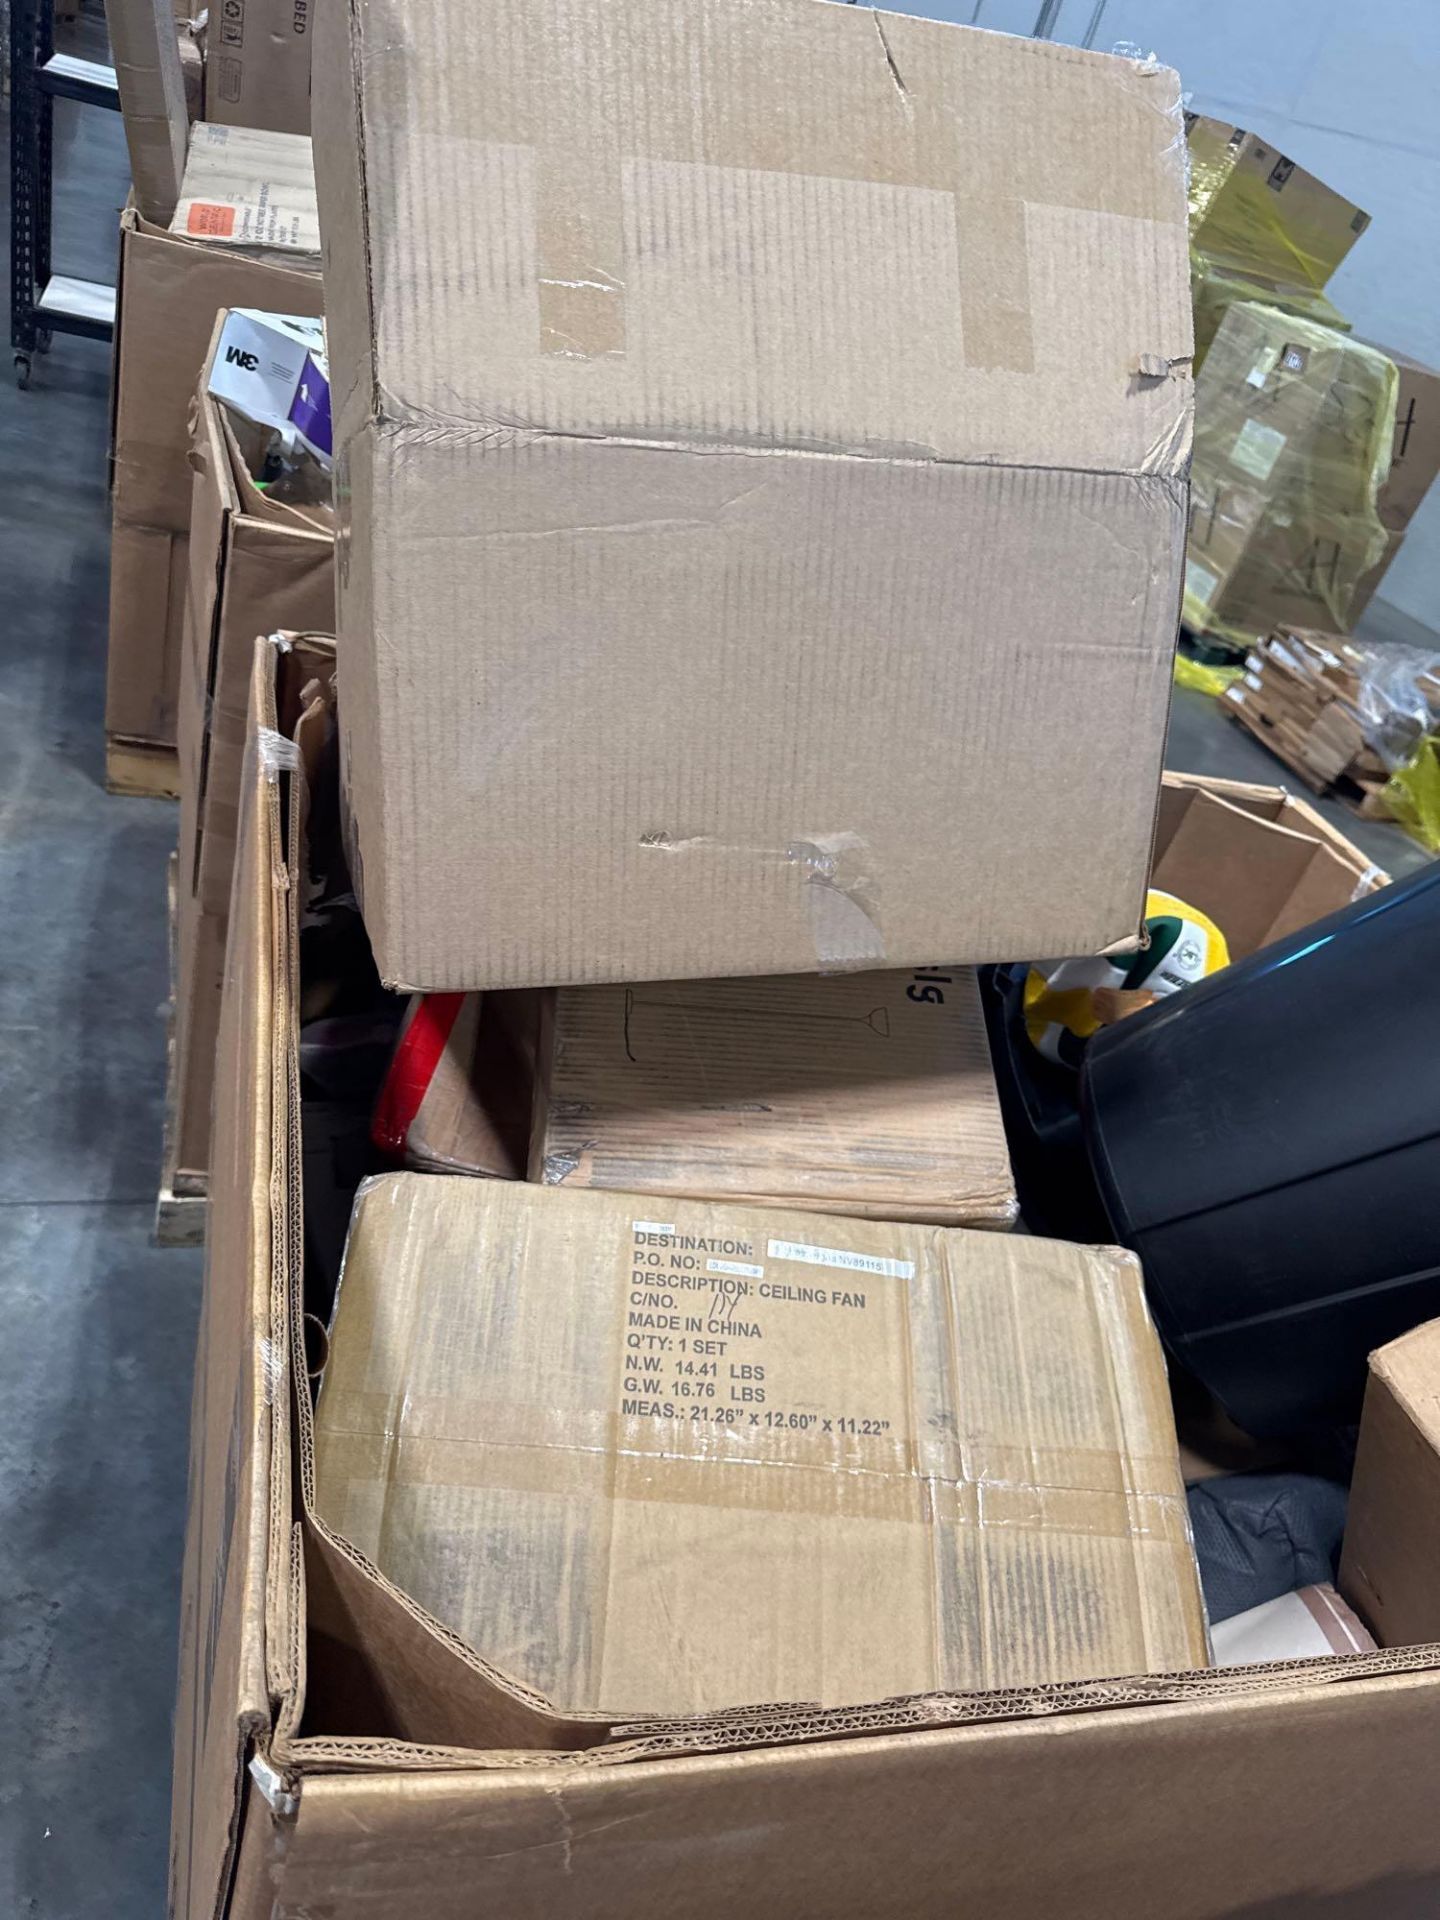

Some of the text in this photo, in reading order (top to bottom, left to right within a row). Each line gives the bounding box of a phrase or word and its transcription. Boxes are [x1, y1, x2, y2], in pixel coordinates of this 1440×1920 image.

[225, 345, 260, 372] 3M
[634, 1231, 753, 1255] DESTINATION:
[632, 1253, 665, 1268] P.O.
[670, 1254, 701, 1271] NO:
[630, 1291, 678, 1309] C/NO.
[631, 1271, 866, 1308] DESCRIPTION: CEILING FAN
[628, 1311, 762, 1338] MADE IN CHINA
[627, 1333, 728, 1356] Q'TY: 1 SET
[625, 1355, 765, 1381] N.W. 14.41 LBS
[623, 1377, 766, 1403] G.W. 16.76 LBS
[622, 1399, 685, 1420] MEAS.:
[750, 1412, 759, 1426] x
[823, 1420, 832, 1431] x
